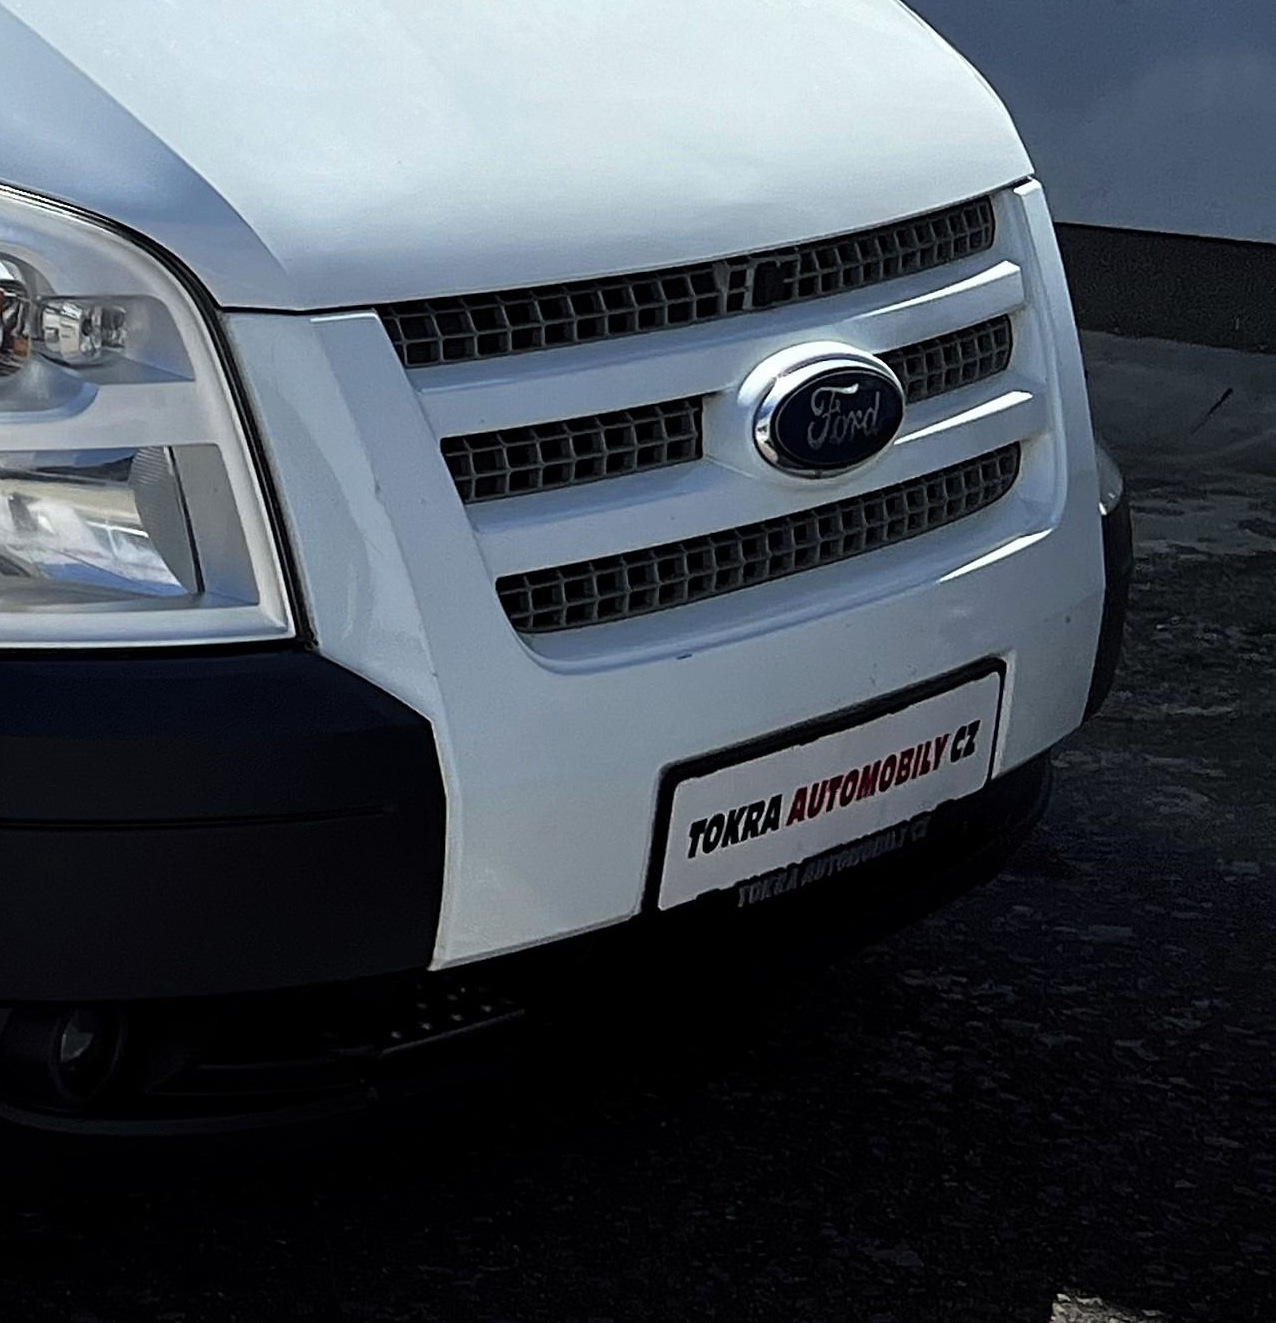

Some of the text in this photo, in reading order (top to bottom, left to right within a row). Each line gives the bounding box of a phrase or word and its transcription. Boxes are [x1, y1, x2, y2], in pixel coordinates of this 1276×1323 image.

[806, 383, 880, 451] Ford
[687, 719, 981, 859] TOKRA AUTOMOBILY CZ
